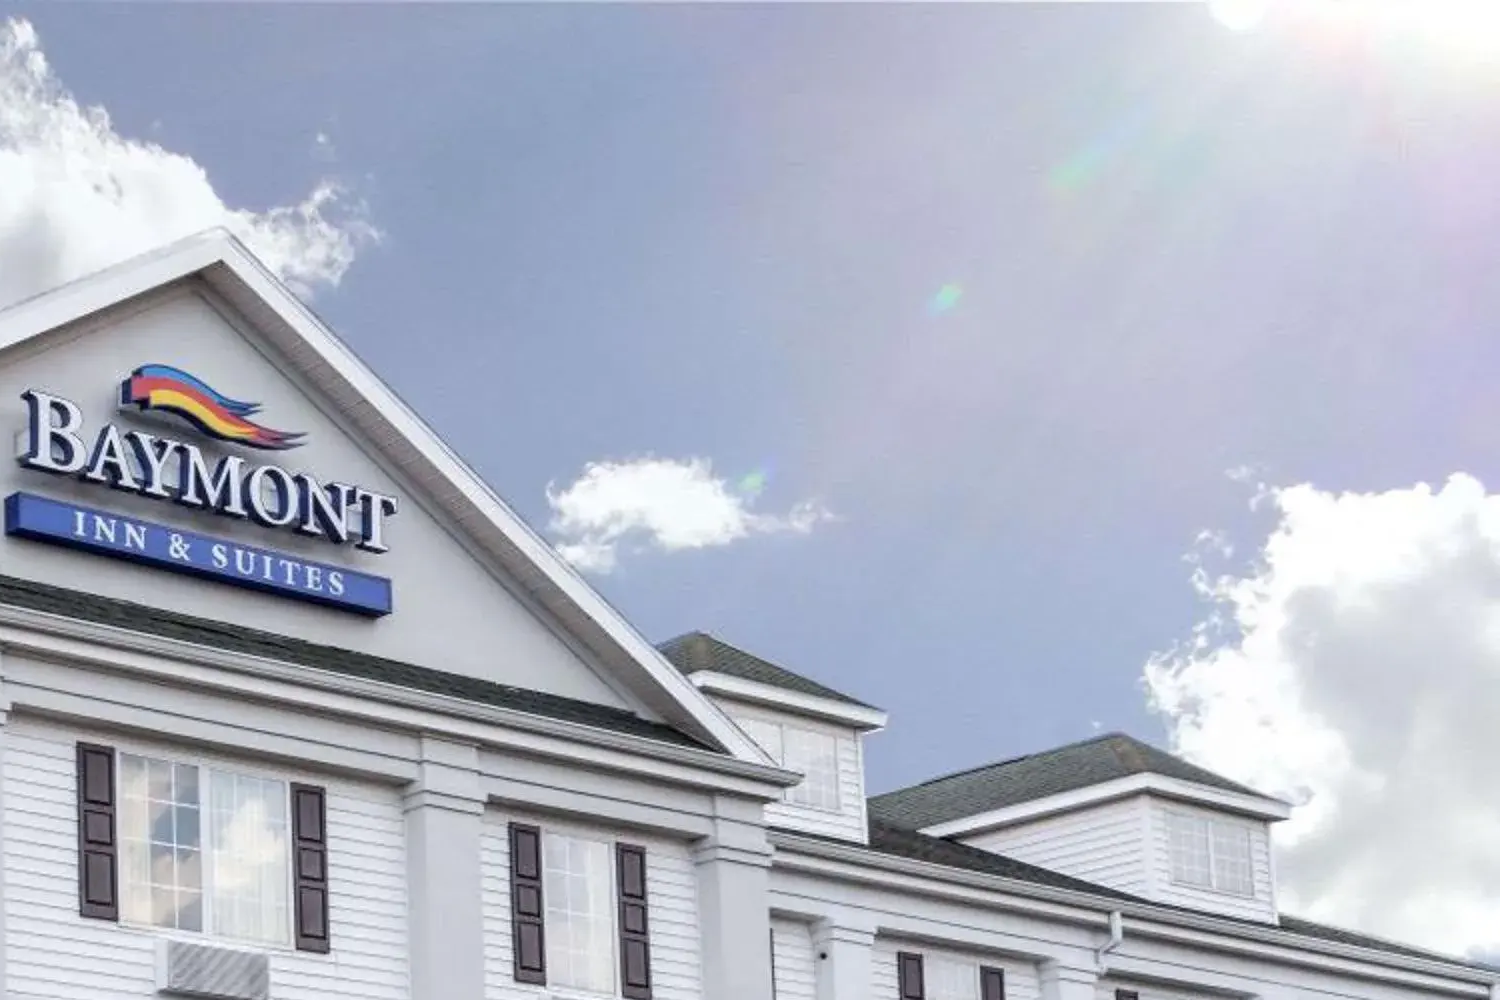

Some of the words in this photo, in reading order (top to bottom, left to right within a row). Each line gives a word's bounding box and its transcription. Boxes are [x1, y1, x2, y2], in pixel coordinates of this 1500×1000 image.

[19, 390, 398, 552] BAYMONT
[74, 511, 147, 550] INN
[169, 534, 192, 561] &
[212, 545, 344, 596] SUITES
